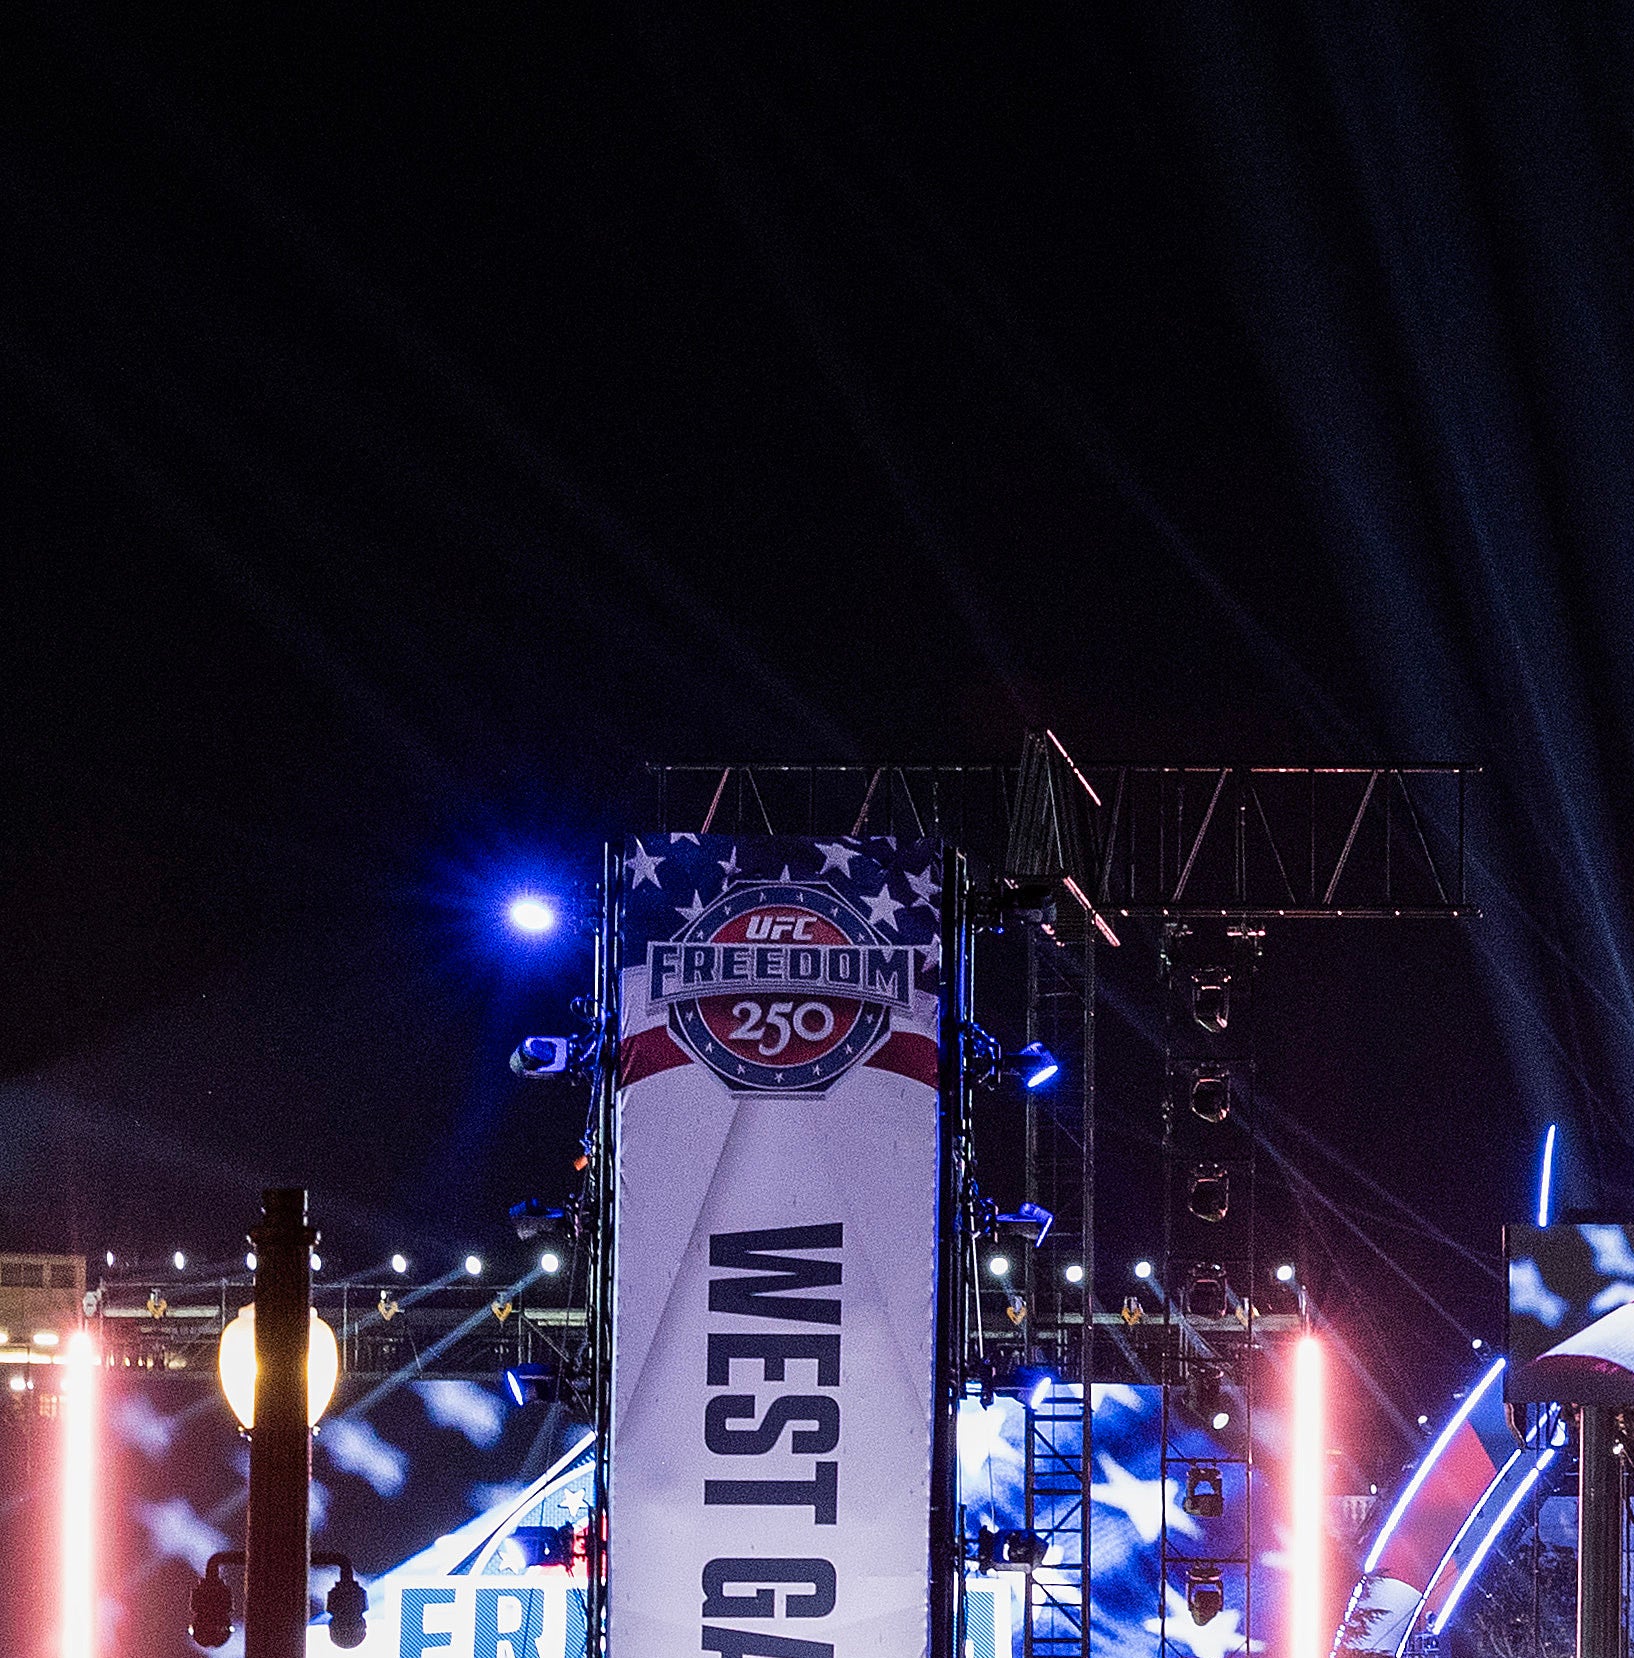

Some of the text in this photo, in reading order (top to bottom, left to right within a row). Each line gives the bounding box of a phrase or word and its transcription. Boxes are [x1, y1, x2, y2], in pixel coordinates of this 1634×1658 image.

[745, 915, 815, 942] UFC
[650, 946, 910, 1001] FREEDOM
[728, 1001, 834, 1056] 250
[704, 1222, 843, 1525] WEST
